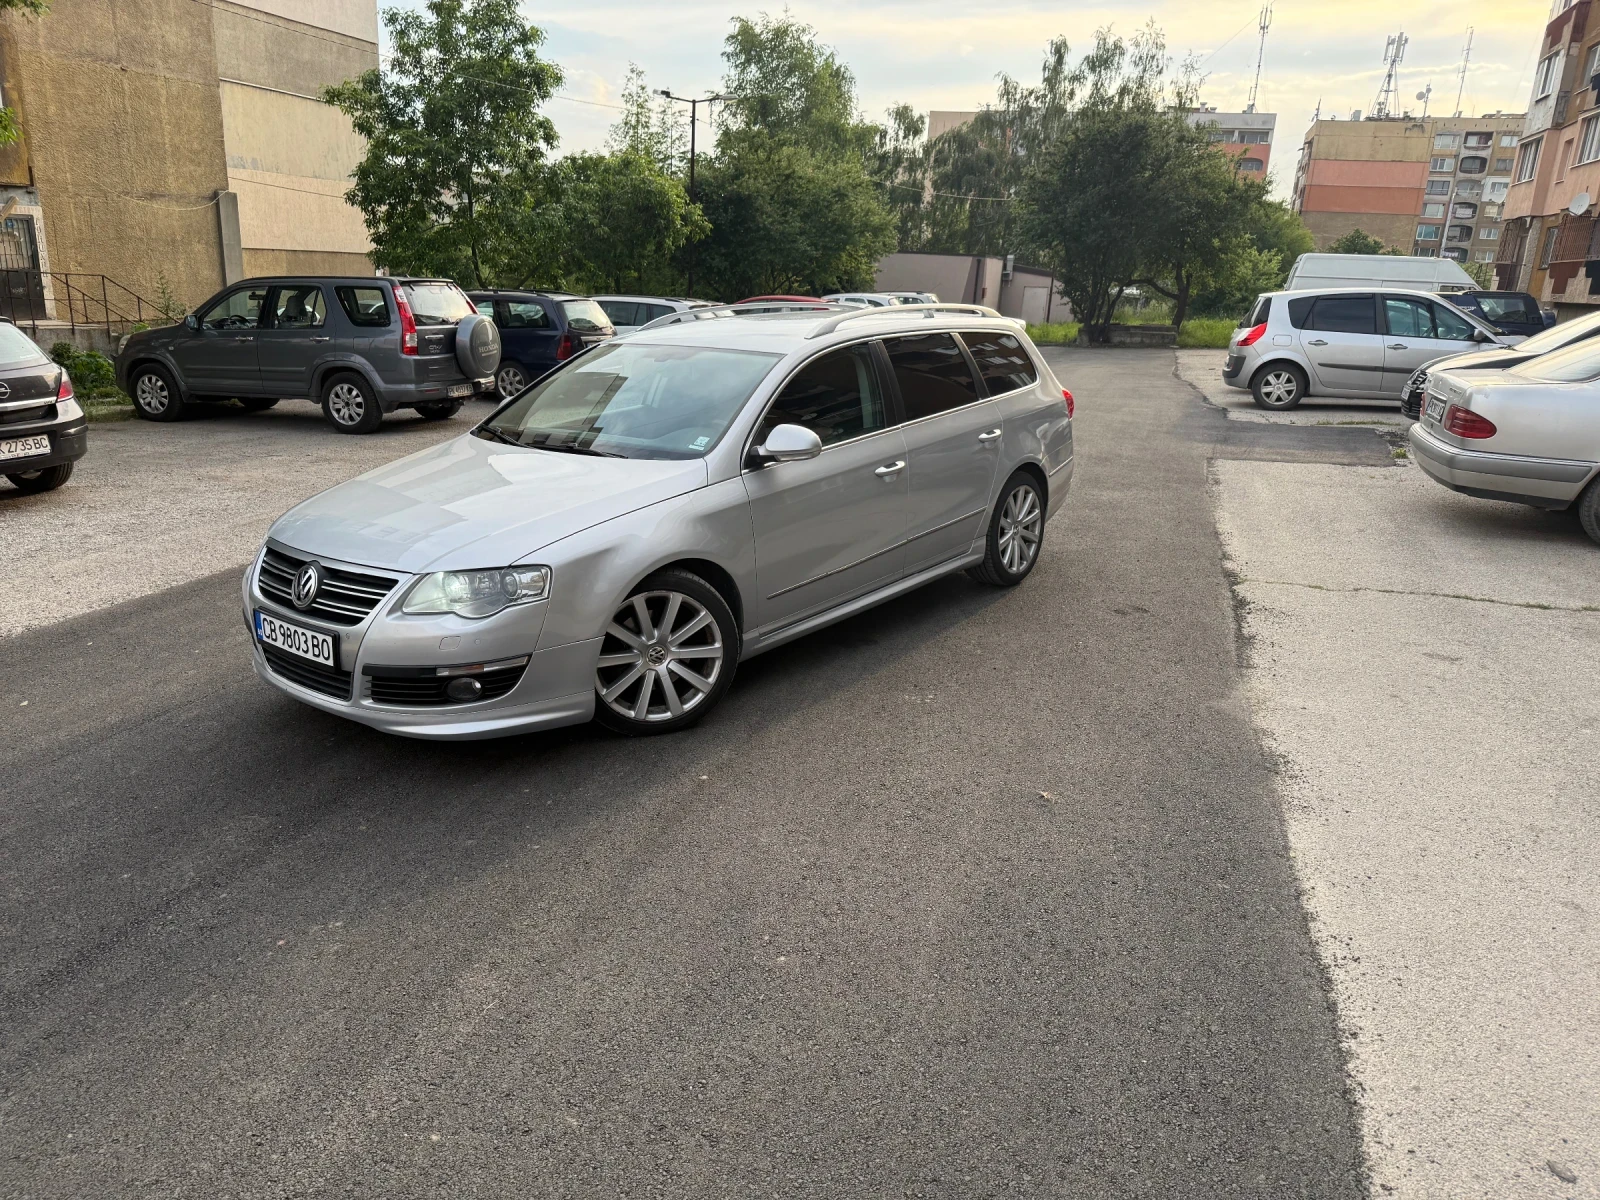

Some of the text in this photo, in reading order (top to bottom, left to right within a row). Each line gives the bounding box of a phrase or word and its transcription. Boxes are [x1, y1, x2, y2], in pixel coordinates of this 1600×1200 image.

[478, 343, 499, 353] HONDA
[5, 439, 33, 454] 2735
[33, 437, 48, 450] BC
[262, 617, 331, 661] CB 9803 BO
